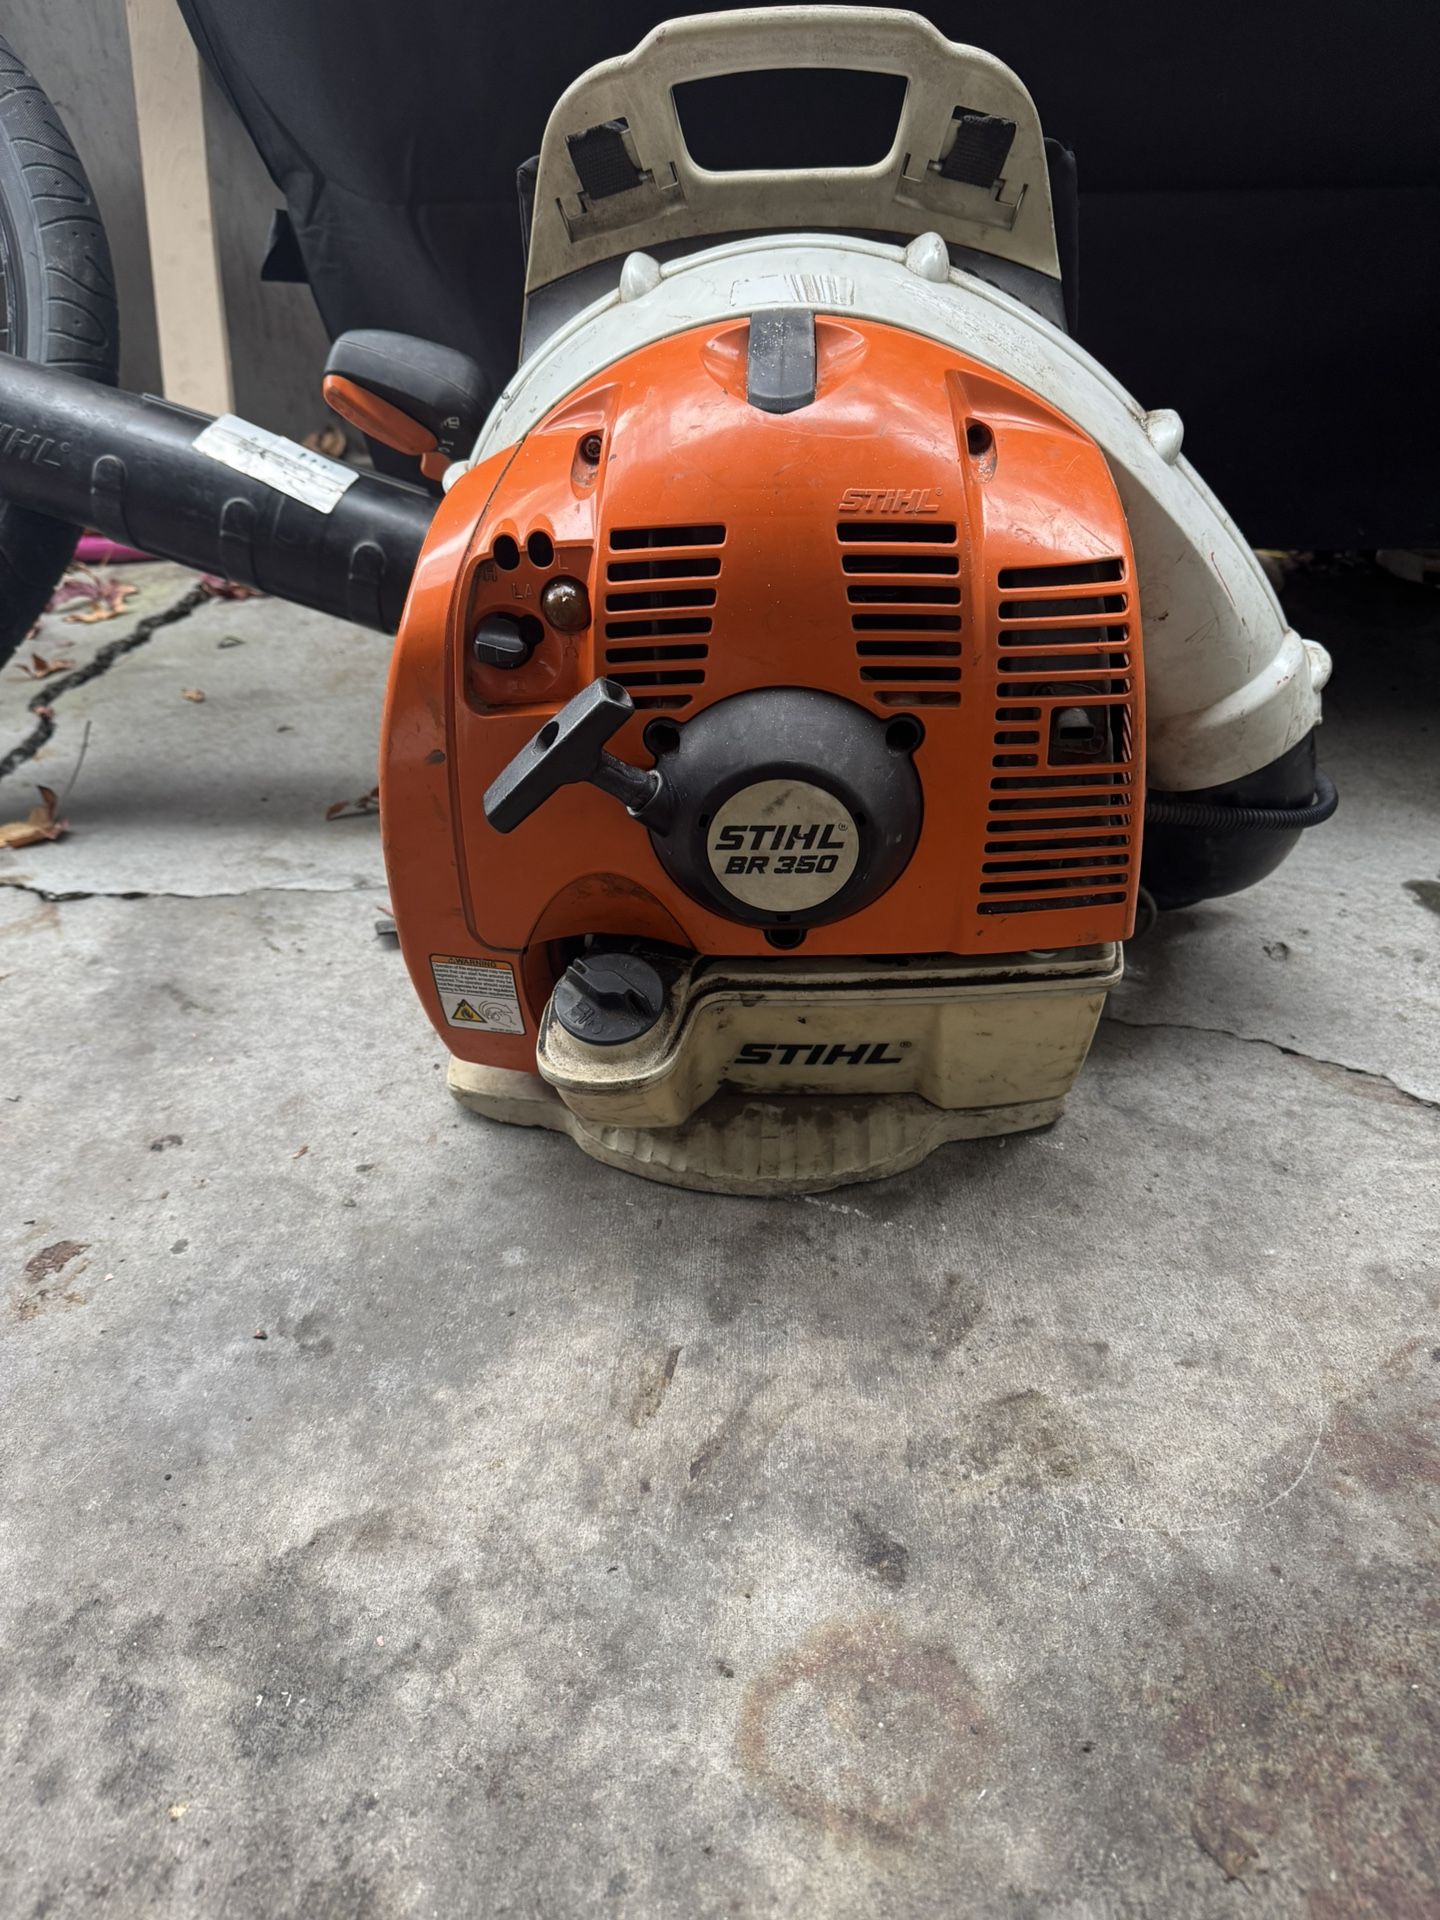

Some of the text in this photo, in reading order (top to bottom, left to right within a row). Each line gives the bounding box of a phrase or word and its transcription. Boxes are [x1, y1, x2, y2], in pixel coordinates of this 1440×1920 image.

[0, 421, 61, 466] IHL
[838, 487, 939, 512] STIHL
[714, 823, 845, 851] STIHL
[724, 854, 840, 875] BR 350
[734, 1043, 903, 1065] STIHL
